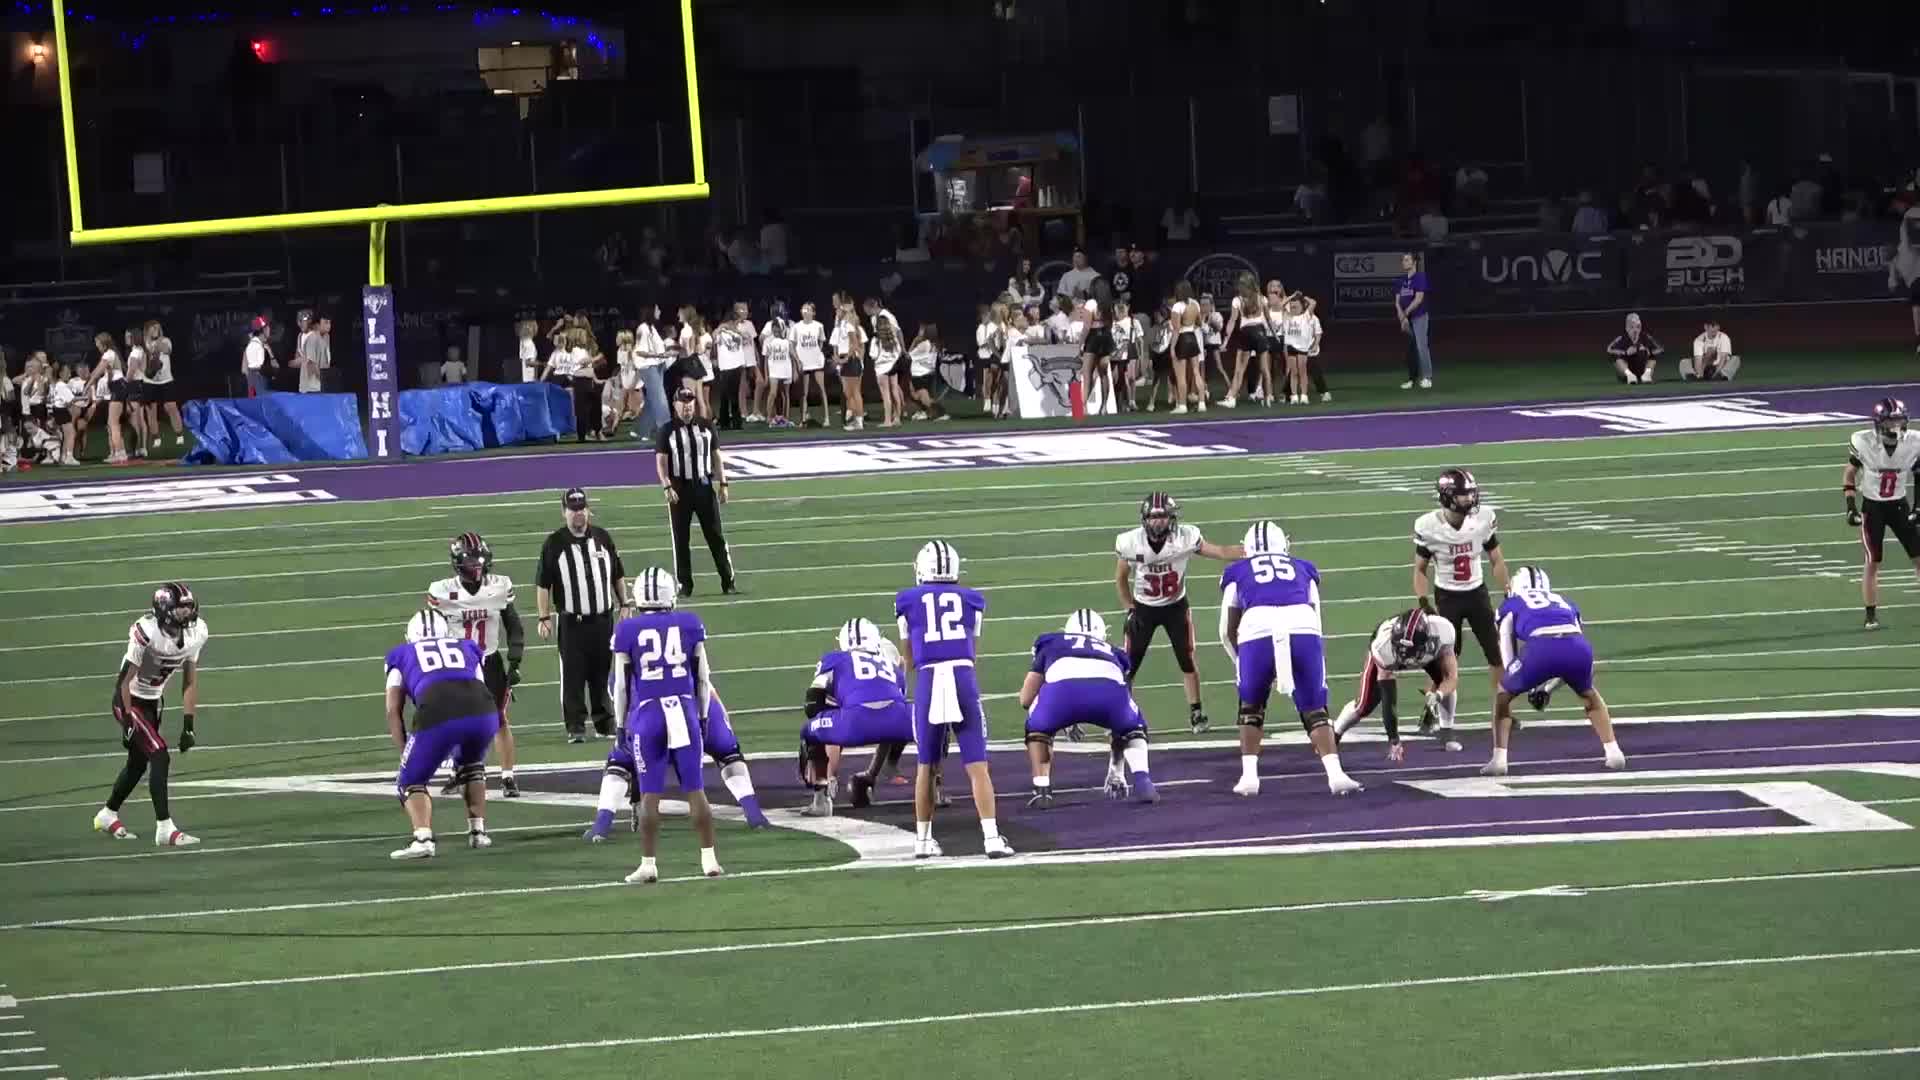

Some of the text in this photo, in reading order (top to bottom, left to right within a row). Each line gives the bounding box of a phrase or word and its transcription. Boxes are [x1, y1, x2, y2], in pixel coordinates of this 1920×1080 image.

[1667, 267, 1745, 287] BUSH
[1250, 556, 1296, 584] 55
[1453, 555, 1472, 581] 9
[1144, 571, 1180, 598] 38
[921, 592, 967, 643] 12
[414, 638, 466, 673] 66
[637, 626, 687, 680] 24
[851, 650, 897, 683] 63
